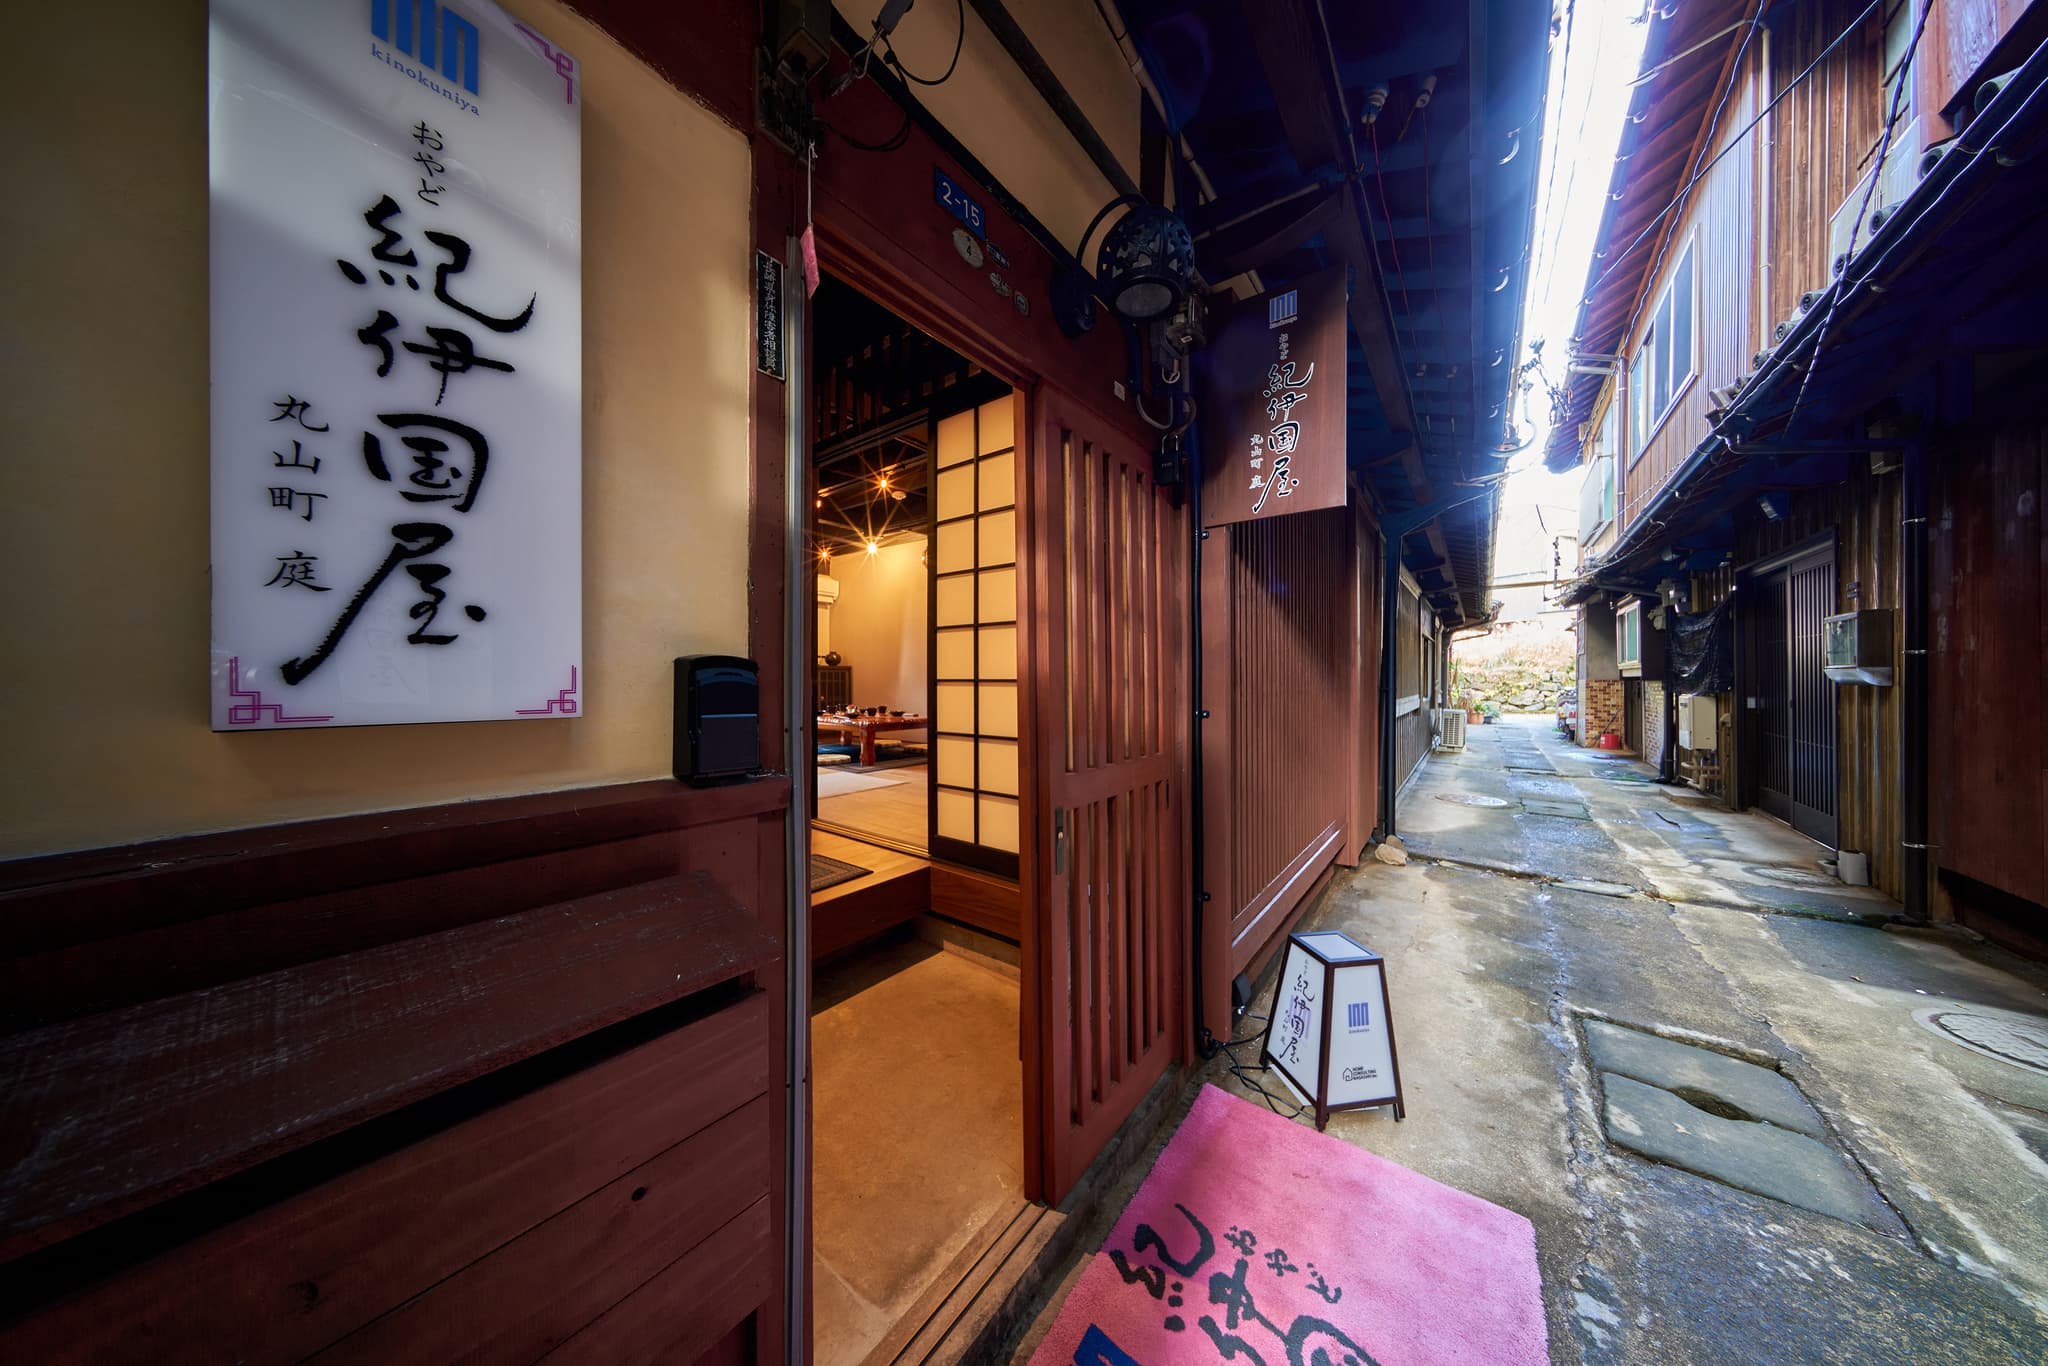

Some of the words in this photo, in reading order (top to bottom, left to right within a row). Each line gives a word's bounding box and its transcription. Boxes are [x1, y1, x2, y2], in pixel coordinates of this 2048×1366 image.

[371, 43, 481, 116] kinokuniya
[413, 120, 446, 206] おやど
[942, 181, 980, 226] 2-15
[268, 394, 330, 522] 丸山町
[280, 194, 537, 686] 紀伊国屋
[1252, 362, 1315, 514] 紀伊国屋
[263, 550, 333, 592] 庭
[1279, 974, 1315, 1064] 紀伊国屋
